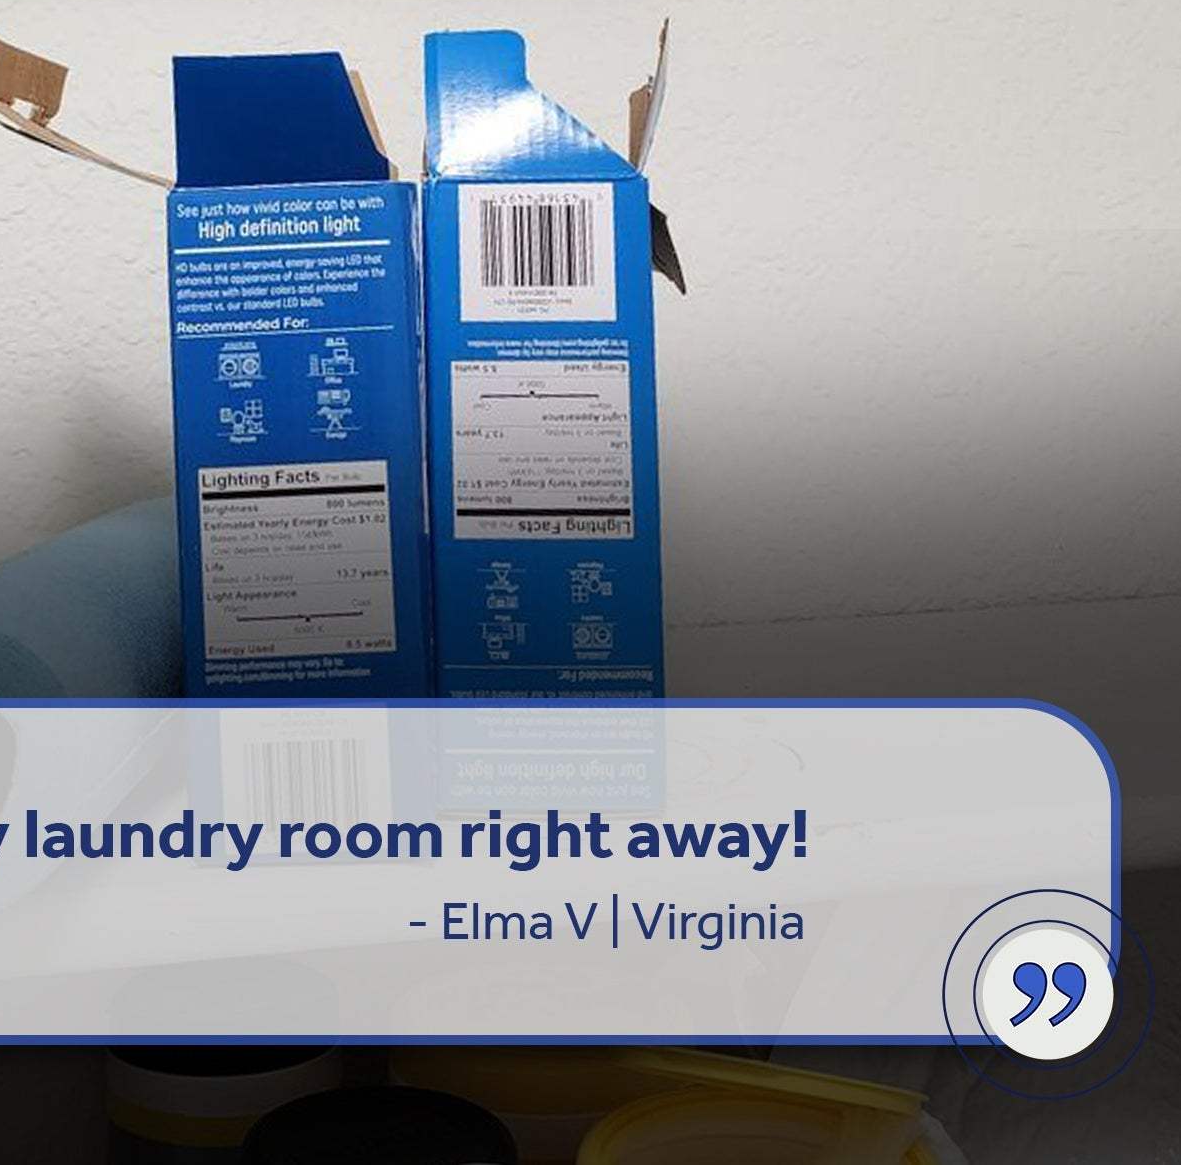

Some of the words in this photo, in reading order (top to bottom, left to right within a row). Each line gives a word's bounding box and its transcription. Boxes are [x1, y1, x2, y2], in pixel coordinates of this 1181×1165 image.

[177, 203, 199, 218] See
[201, 204, 223, 219] just
[226, 202, 250, 215] how
[253, 200, 280, 214] vivid
[283, 199, 312, 212] color
[316, 200, 338, 211] can
[340, 196, 356, 211] be
[358, 196, 384, 209] with
[198, 220, 235, 242] High
[240, 215, 319, 237] definition
[323, 214, 361, 236] light
[323, 269, 370, 280] Experience
[177, 317, 280, 333] Recommended
[283, 316, 309, 329] For:
[202, 472, 270, 490] Lighting
[275, 469, 321, 485] Facts
[203, 504, 259, 515] Brightness
[346, 498, 385, 508] lumens
[204, 520, 256, 531] Estimated
[258, 518, 290, 529] Yearly
[292, 517, 328, 527] Energy
[331, 515, 357, 525] Cost
[518, 520, 562, 534] Facts
[566, 517, 631, 534] Lighting
[360, 569, 388, 579] years
[207, 592, 233, 603] Light
[236, 590, 297, 601] Appearance
[209, 645, 244, 655] Energy
[247, 644, 275, 653] Used
